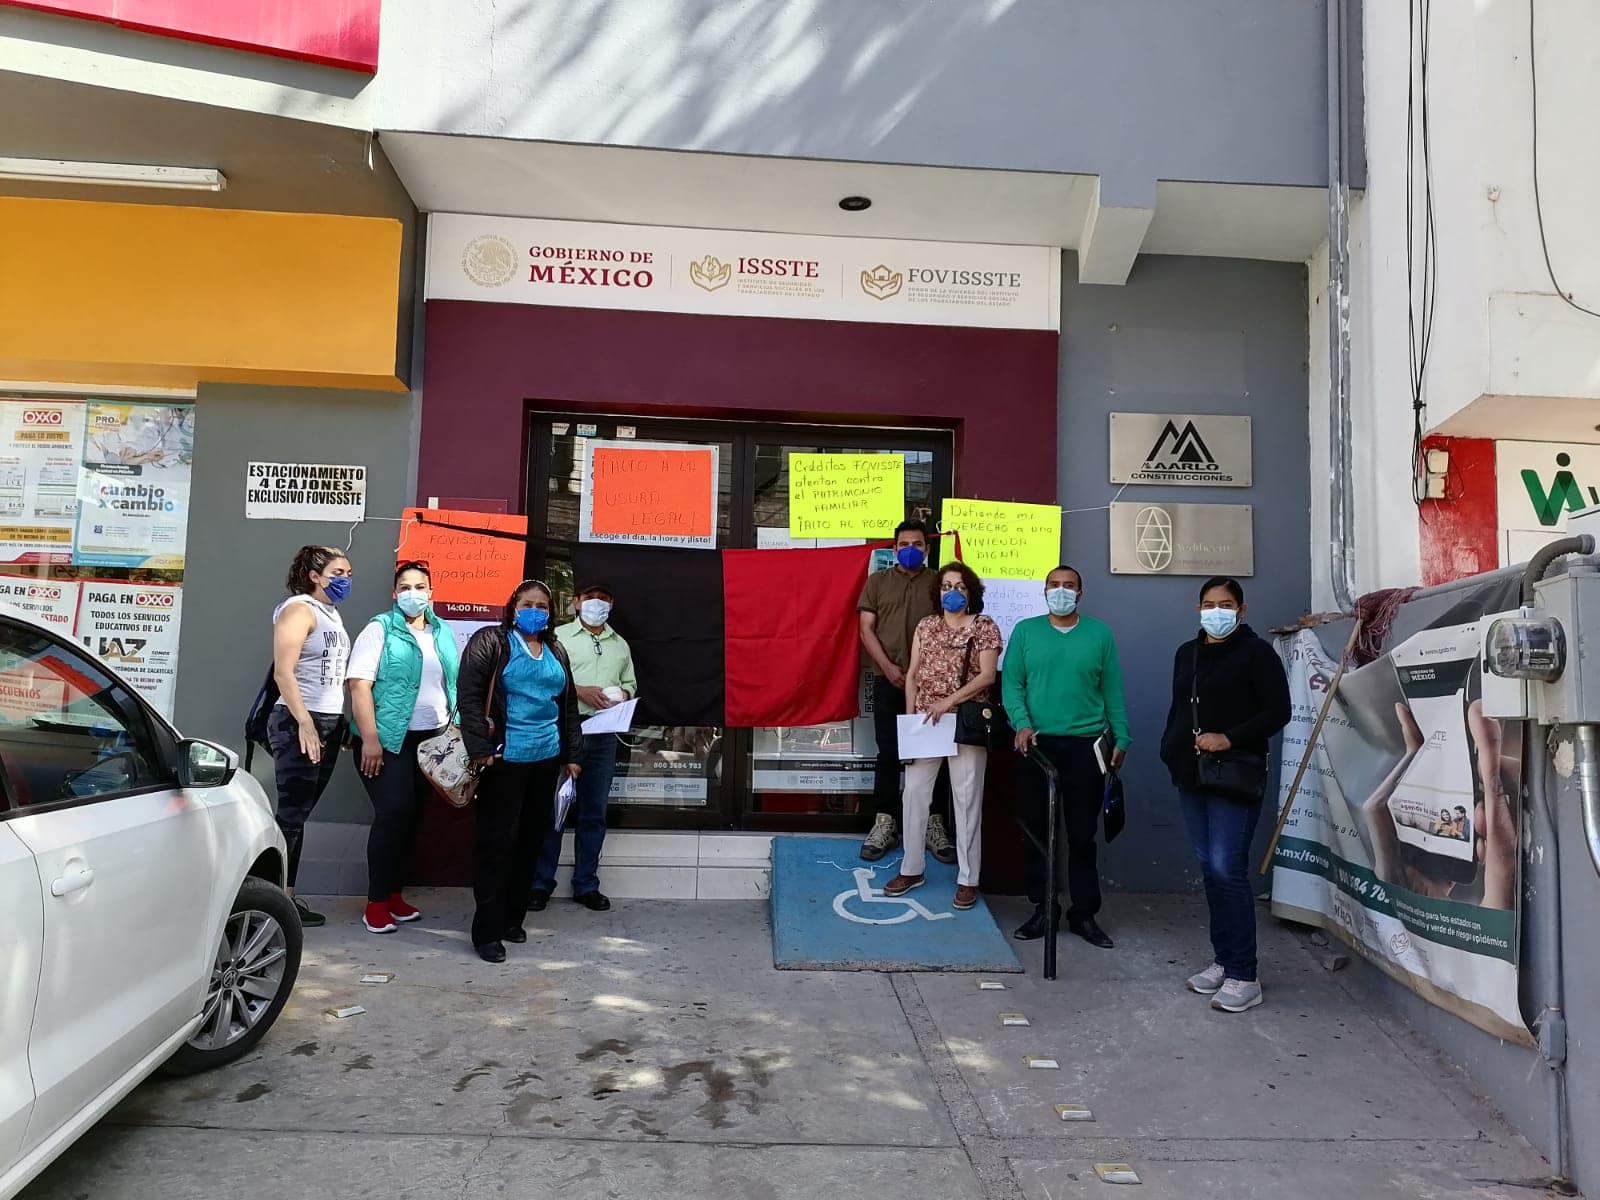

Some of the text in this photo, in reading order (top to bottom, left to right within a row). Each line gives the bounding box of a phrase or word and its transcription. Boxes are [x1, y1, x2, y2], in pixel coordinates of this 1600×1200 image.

[529, 246, 653, 264] GOBIERNO DE
[528, 260, 653, 288] MÉXICO
[738, 257, 819, 278] ISSSTE
[908, 268, 1021, 288] FOVISSSTE
[23, 411, 62, 424] OXXO
[249, 465, 364, 480] ESTACIONAMIENTO
[846, 472, 883, 484] contra
[1131, 473, 1233, 481] CONSTRUCCIONES
[259, 478, 353, 491] 4 CAJONES
[248, 489, 362, 505] EXCLUSIVO FOVISSSTE
[14, 586, 25, 595] EN
[88, 592, 174, 607] PAGA EN OXXO
[446, 603, 490, 613] 14:00 hrs.
[91, 611, 170, 622] TODOS LOS SERVICIOS
[95, 622, 163, 633] EDUCATIVOS DE LA
